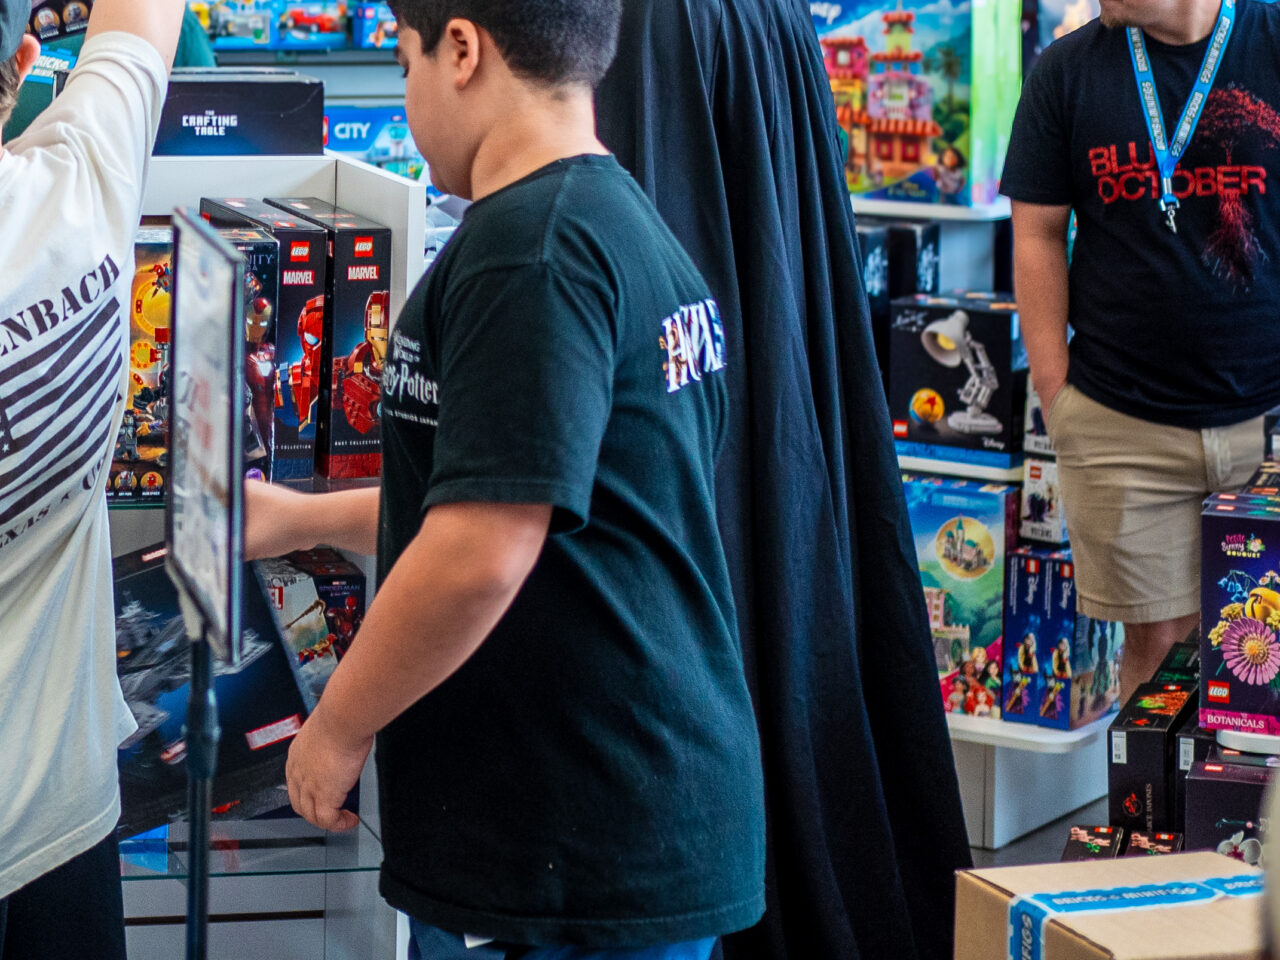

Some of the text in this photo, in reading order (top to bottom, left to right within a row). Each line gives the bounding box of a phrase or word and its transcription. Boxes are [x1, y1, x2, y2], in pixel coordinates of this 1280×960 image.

[182, 115, 238, 127] CRAFTING
[194, 127, 226, 136] TABLE
[334, 123, 370, 138] CITY
[1089, 141, 1158, 176] BLU
[1098, 165, 1267, 204] OCTOBER
[292, 246, 308, 257] LEGO
[356, 242, 372, 252] LEGO
[284, 271, 313, 285] MARVEL
[348, 266, 378, 280] MARVEL
[399, 361, 440, 405] Potter
[1209, 687, 1228, 698] LEGO
[1207, 715, 1265, 730] BOTANICALS
